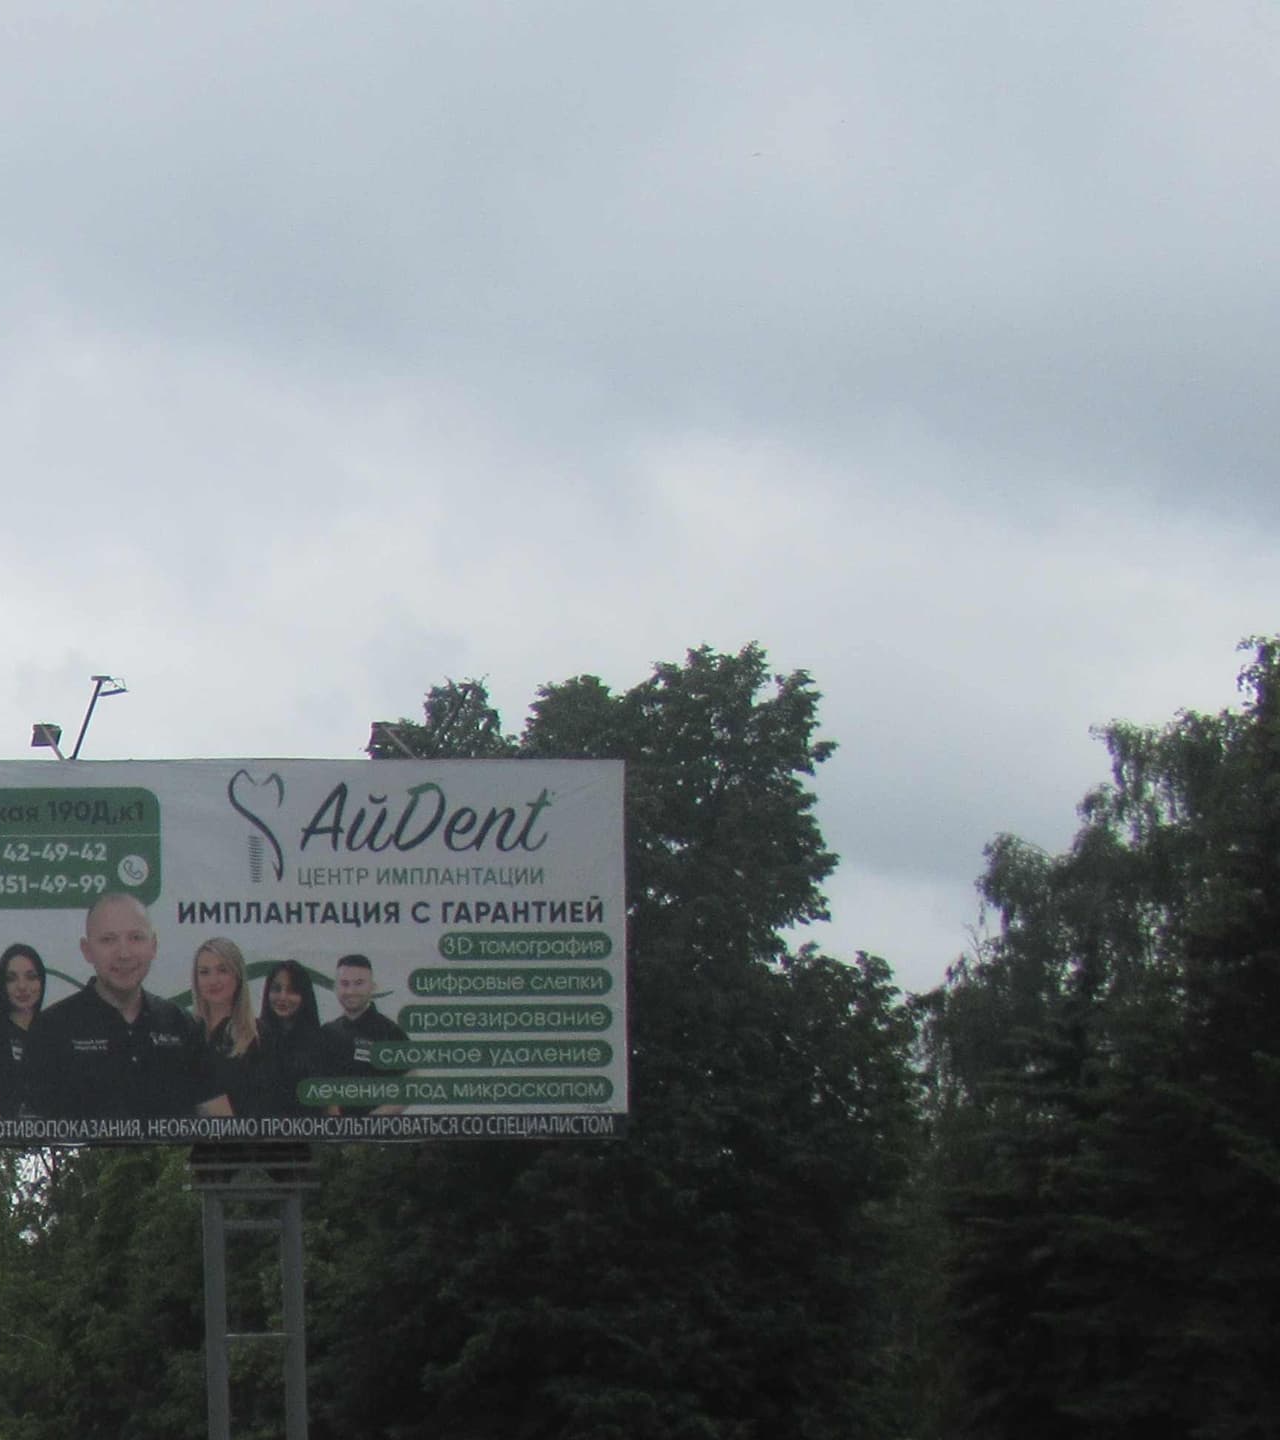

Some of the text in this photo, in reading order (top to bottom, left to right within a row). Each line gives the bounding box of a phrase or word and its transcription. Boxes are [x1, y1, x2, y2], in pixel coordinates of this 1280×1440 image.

[299, 781, 555, 853] АйDent
[3, 843, 108, 863] 42-49-42
[298, 867, 545, 889] ЦЕНТР ИМПЛАНТАЦИИ
[178, 895, 604, 927] ИМПЛАНТАЦИЯ С ГАРАНТИЕЙ
[443, 935, 605, 959] 3D томография
[415, 971, 604, 996] цифровые слепки
[409, 1009, 606, 1029] протезирование
[378, 1045, 601, 1067] сложное удаление
[306, 1080, 605, 1102] лечение под микроскопом
[148, 1117, 258, 1139] НЕОБХОДИМО
[260, 1116, 458, 1138] ПРОКОНСУЛЬТИРОВАТЬСЯ
[461, 1116, 483, 1135] СО
[486, 1115, 614, 1137] СПЕЦИАЛИСТОМ
